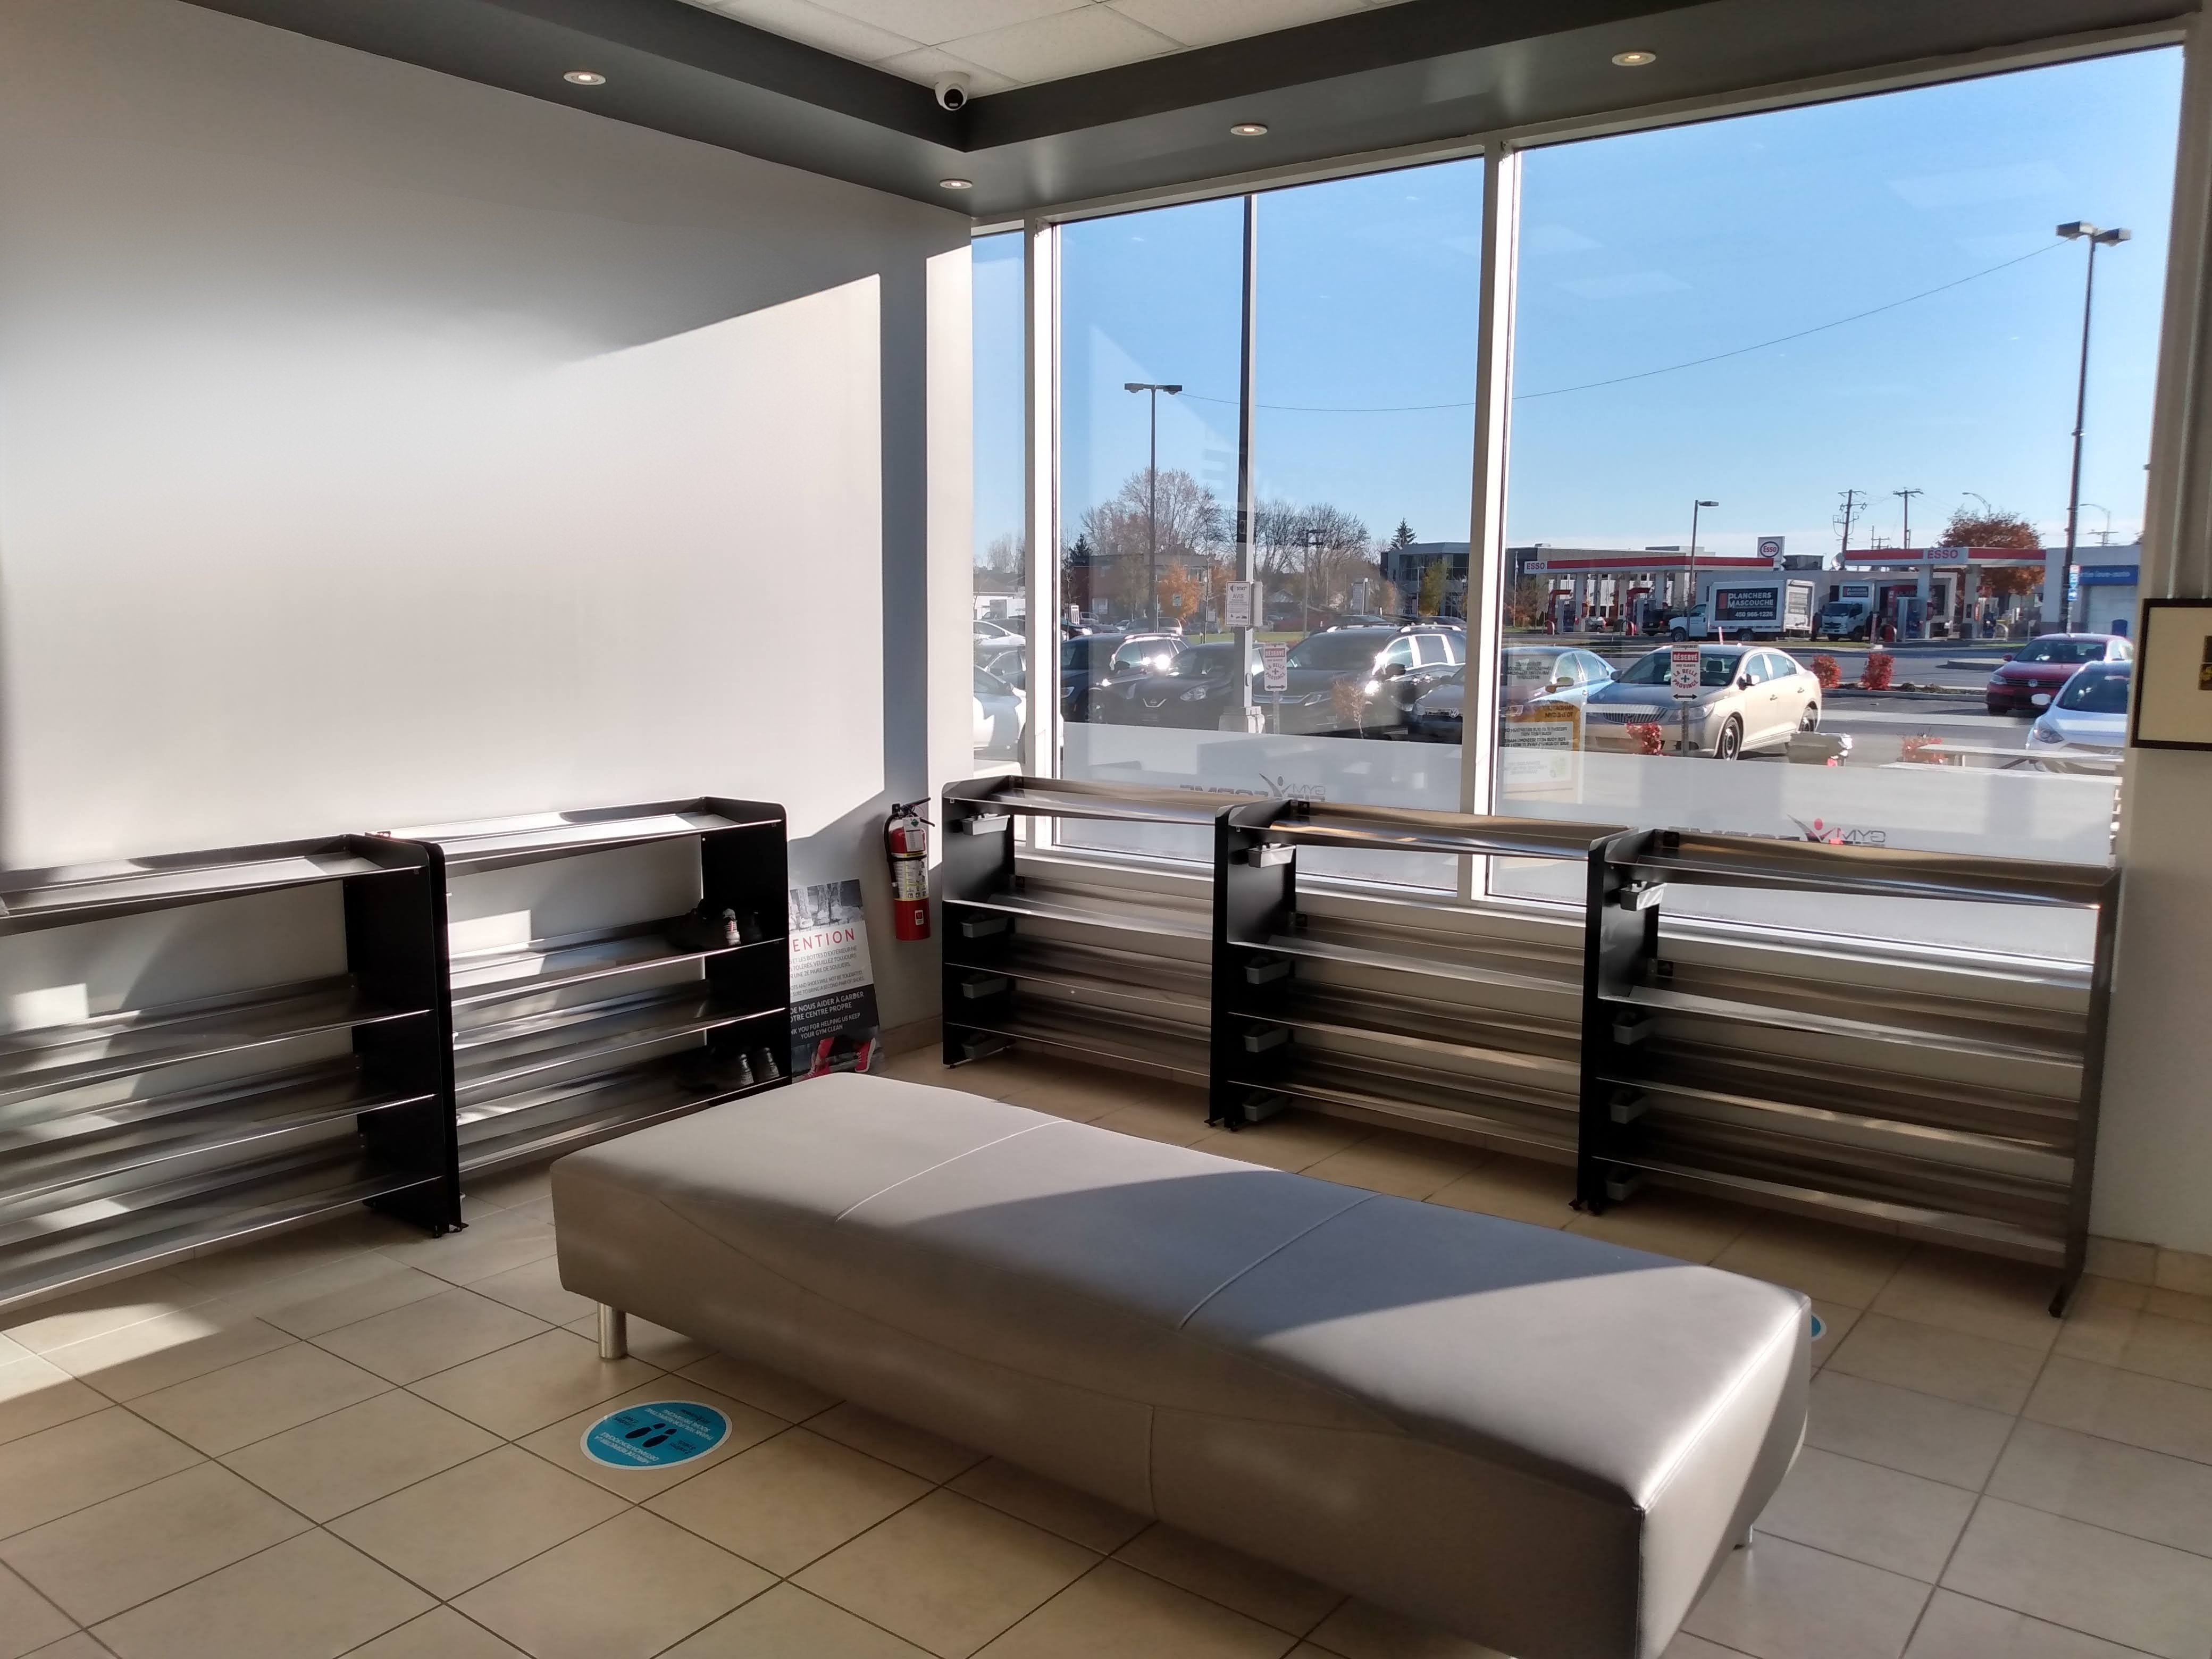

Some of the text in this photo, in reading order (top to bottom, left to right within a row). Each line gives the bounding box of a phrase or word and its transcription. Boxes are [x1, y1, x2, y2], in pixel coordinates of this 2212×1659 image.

[1928, 549, 1958, 558] ESSO
[1728, 599, 1774, 608] MASCOUCHE
[1682, 668, 1698, 677] BELLE
[1672, 679, 1699, 689] PROVINCE
[792, 928, 855, 952] ENTION
[799, 1002, 816, 1012] NOUS
[817, 998, 834, 1008] AIDER
[790, 1002, 852, 1023] OTRE CENTRE PROPRE
[820, 1017, 841, 1027] HELPING
[815, 1027, 826, 1036] GYM
[827, 1024, 843, 1033] CLEAN
